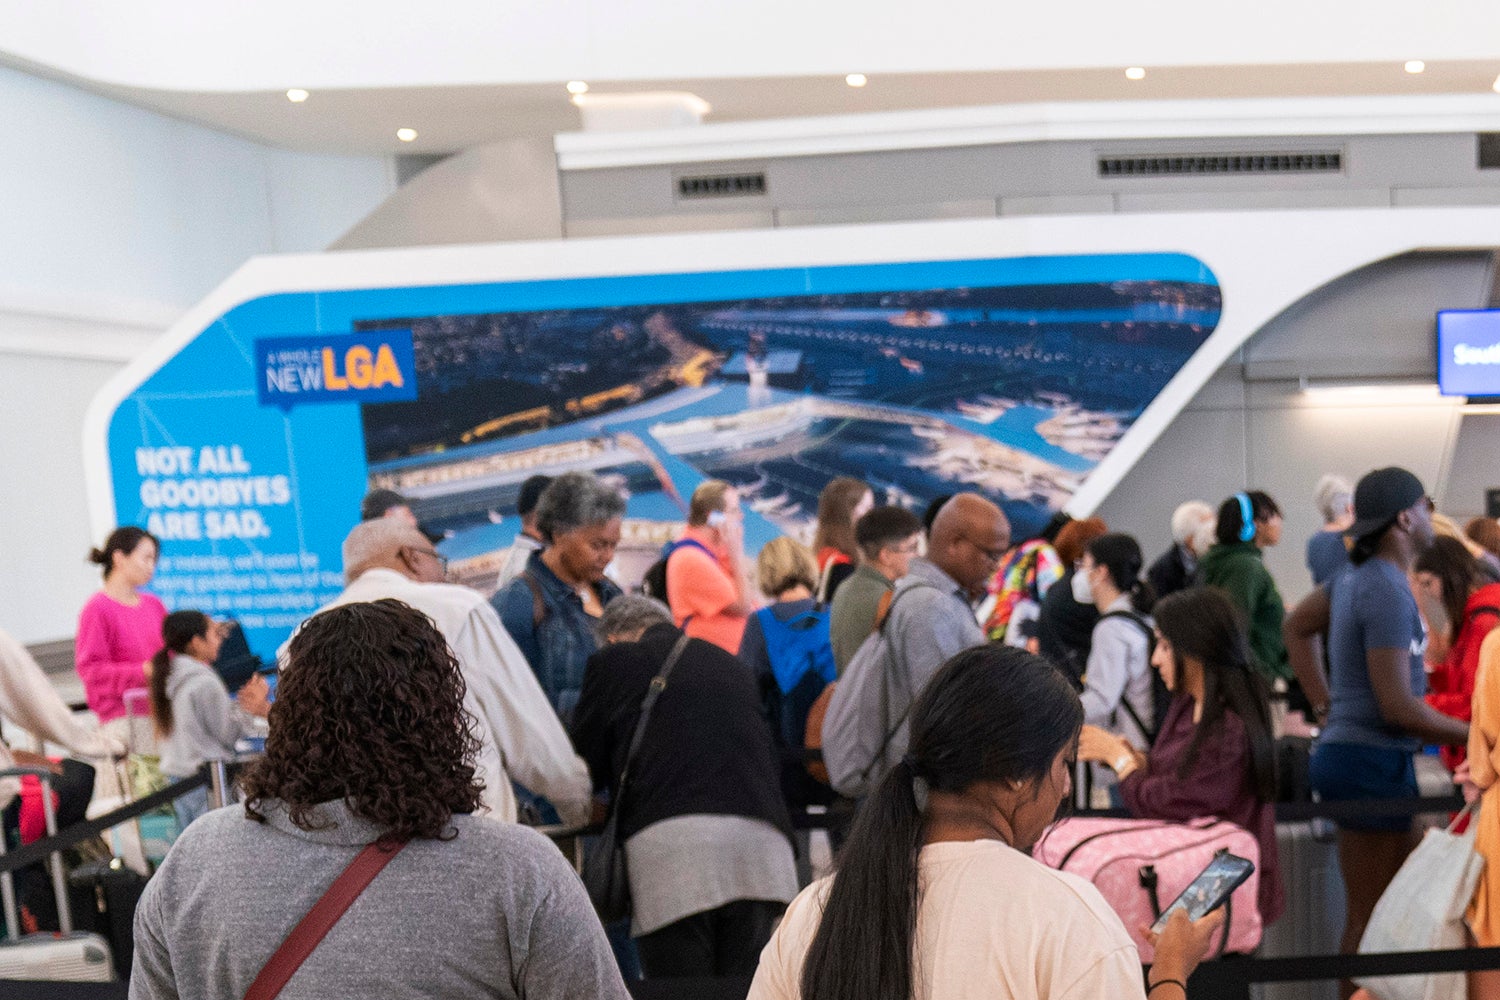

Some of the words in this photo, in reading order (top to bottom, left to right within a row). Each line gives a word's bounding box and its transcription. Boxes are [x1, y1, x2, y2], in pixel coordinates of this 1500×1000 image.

[266, 364, 321, 392] NEW
[322, 343, 404, 390] LGA
[135, 446, 193, 476] NOT
[198, 444, 250, 474] ALL
[140, 474, 290, 508] GOODBYES
[148, 511, 200, 540] ARE
[204, 508, 271, 539] SAD.
